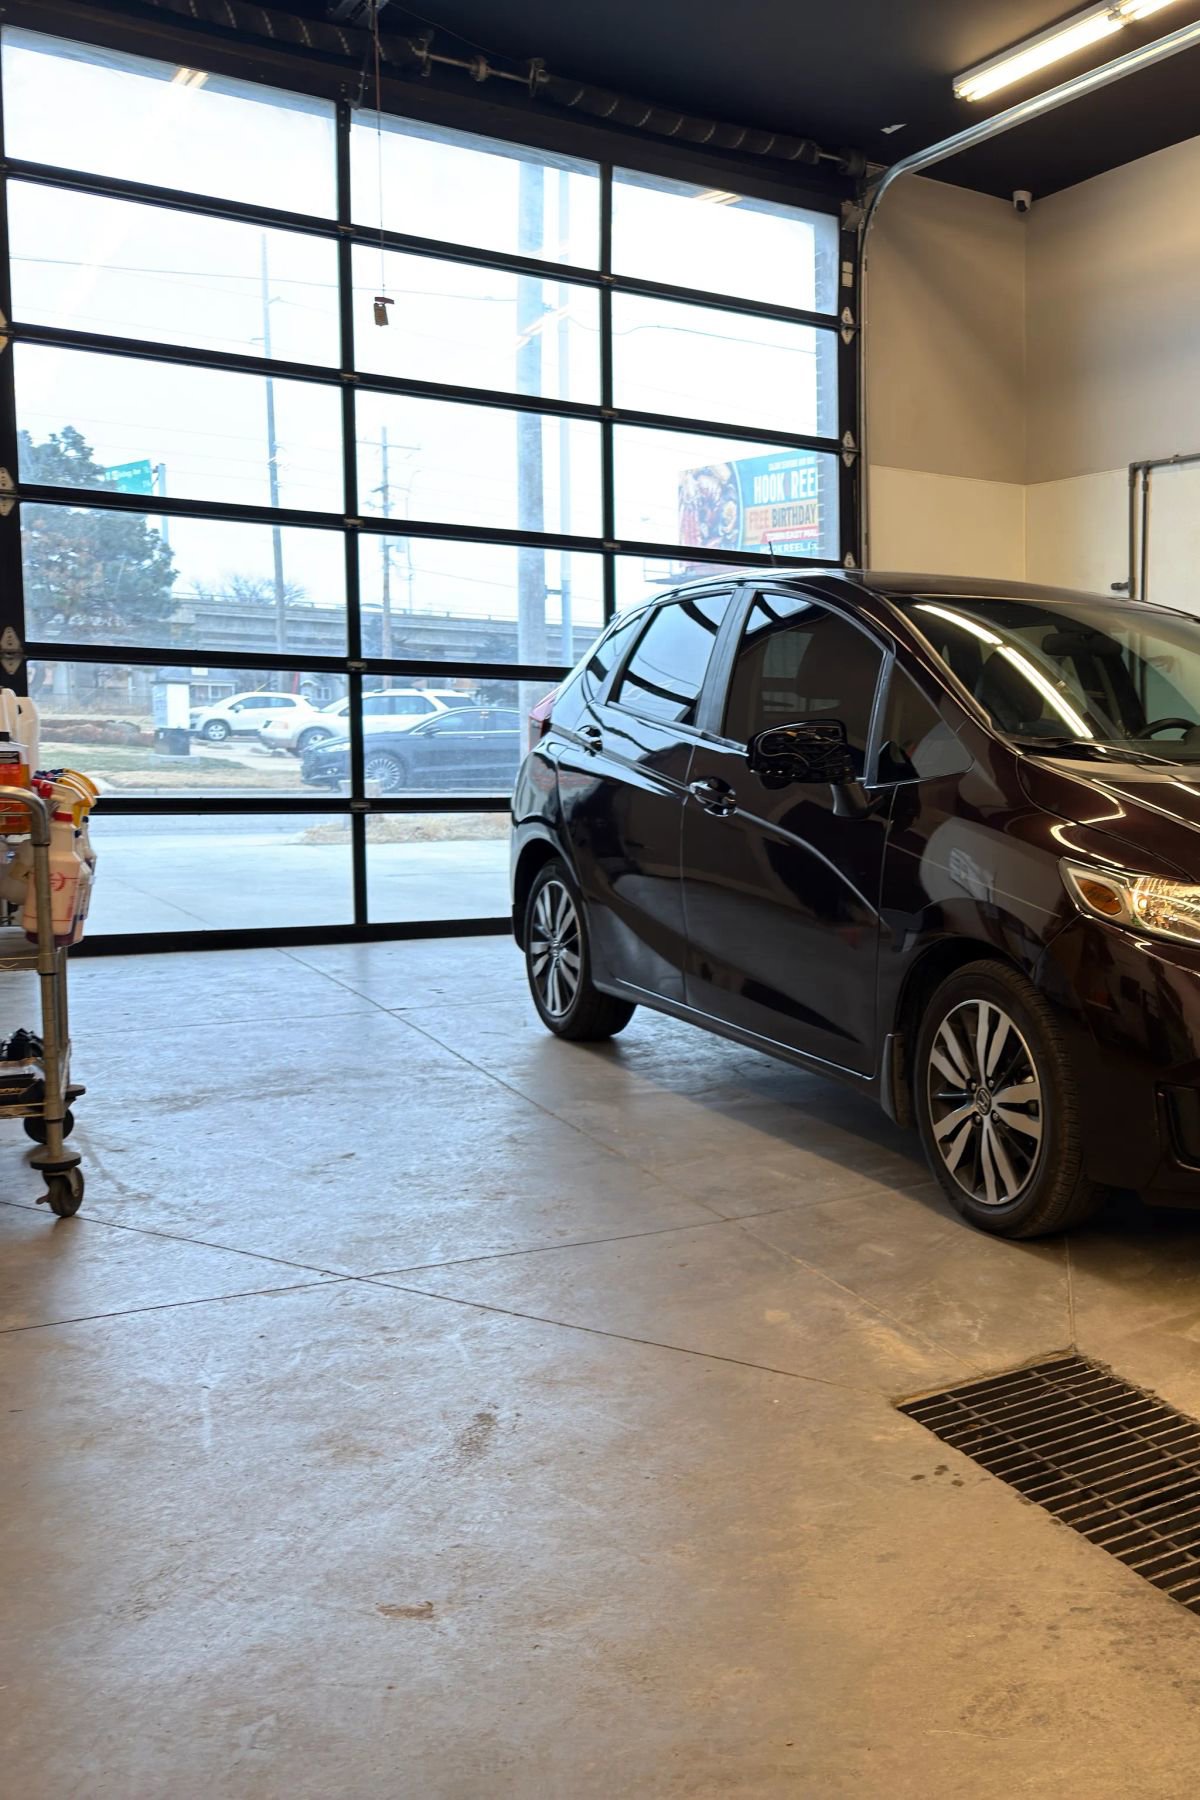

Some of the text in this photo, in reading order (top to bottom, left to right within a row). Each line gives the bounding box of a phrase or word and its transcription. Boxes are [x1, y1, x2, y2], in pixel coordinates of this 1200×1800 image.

[753, 472, 785, 504] HOOK
[749, 504, 817, 529] FREE BIRTHDAY
